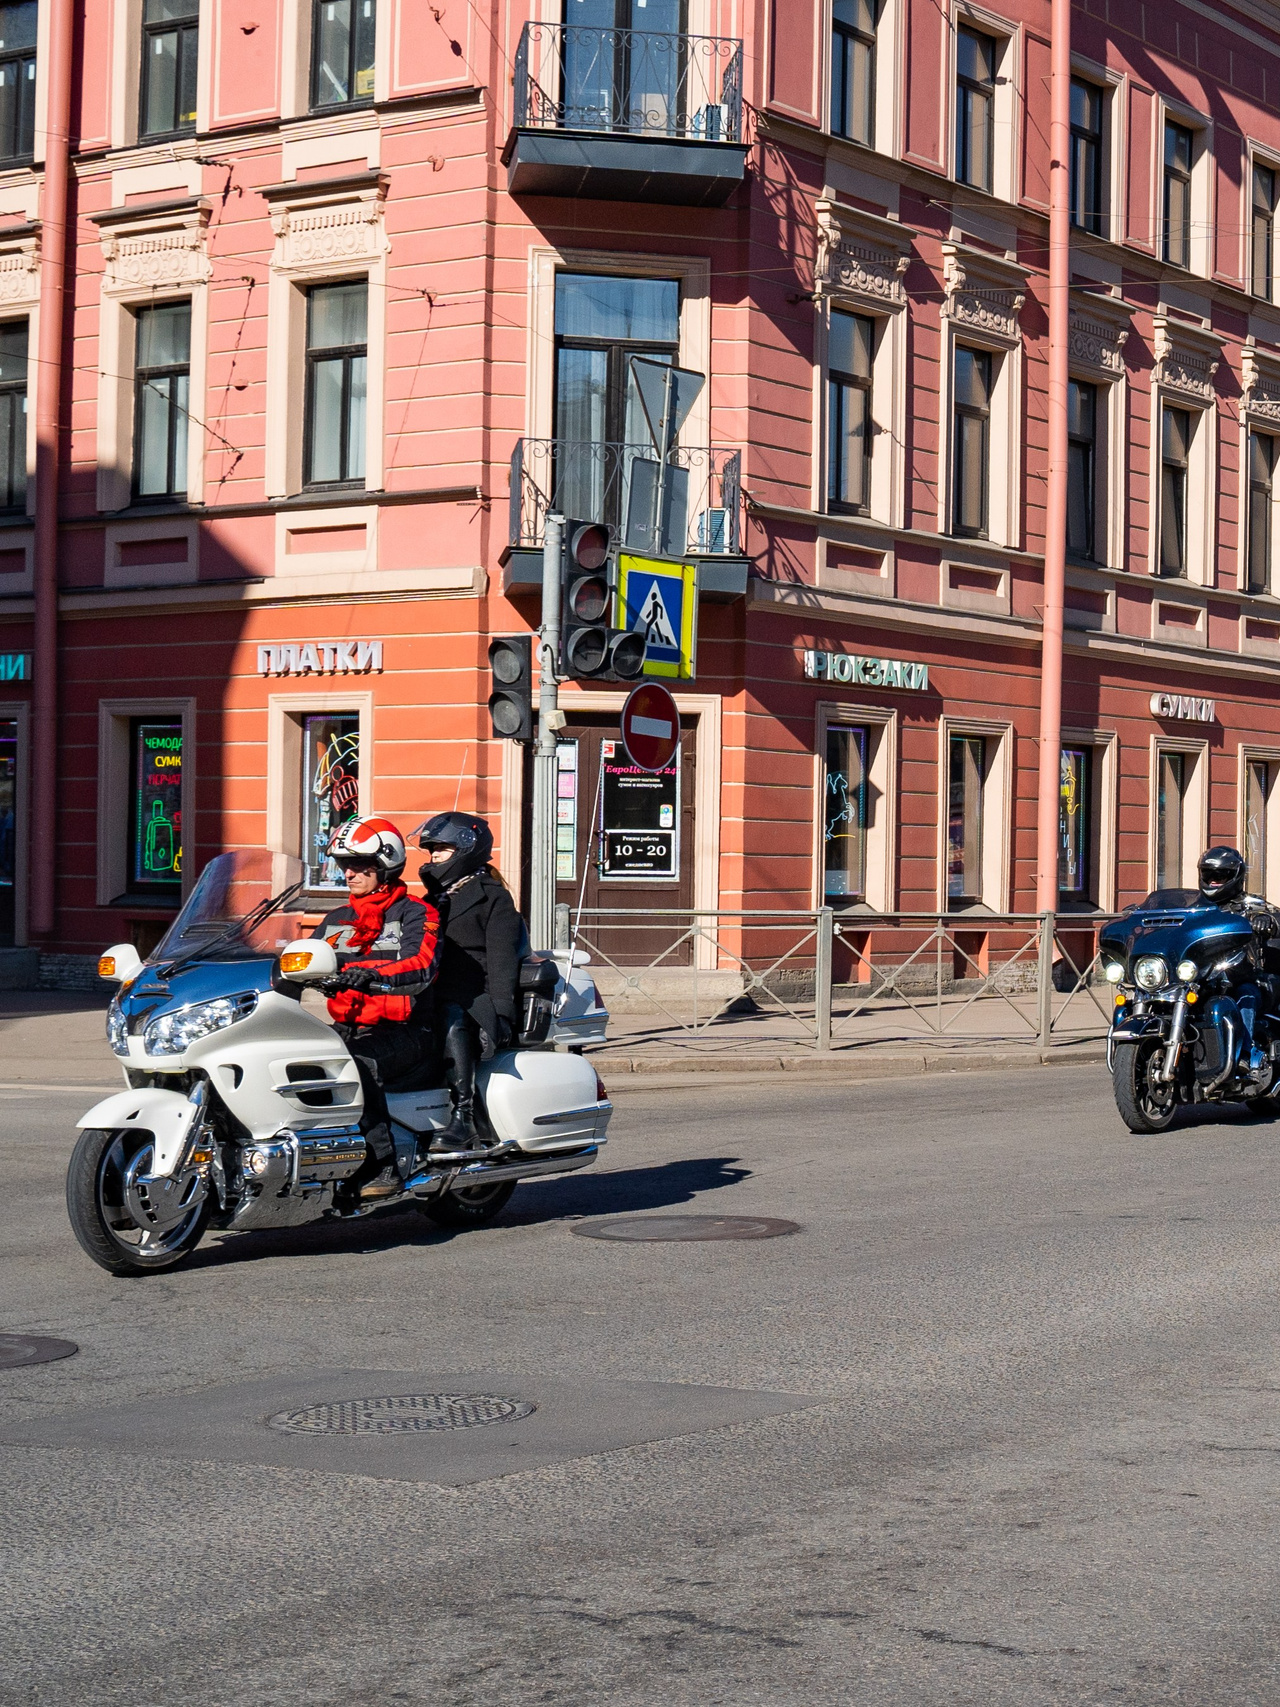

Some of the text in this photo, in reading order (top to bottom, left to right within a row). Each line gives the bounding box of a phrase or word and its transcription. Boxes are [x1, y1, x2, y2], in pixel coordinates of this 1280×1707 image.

[257, 641, 382, 672] ПЛАТКИ
[806, 651, 928, 690] РЮКЗАКИ
[1151, 693, 1215, 722] СУМКИ
[145, 737, 183, 751] ЧЕМОДА
[155, 756, 182, 767] СУМК
[148, 774, 182, 785] ПЕРЧАТ
[615, 844, 633, 856] 10
[646, 845, 667, 856] 20
